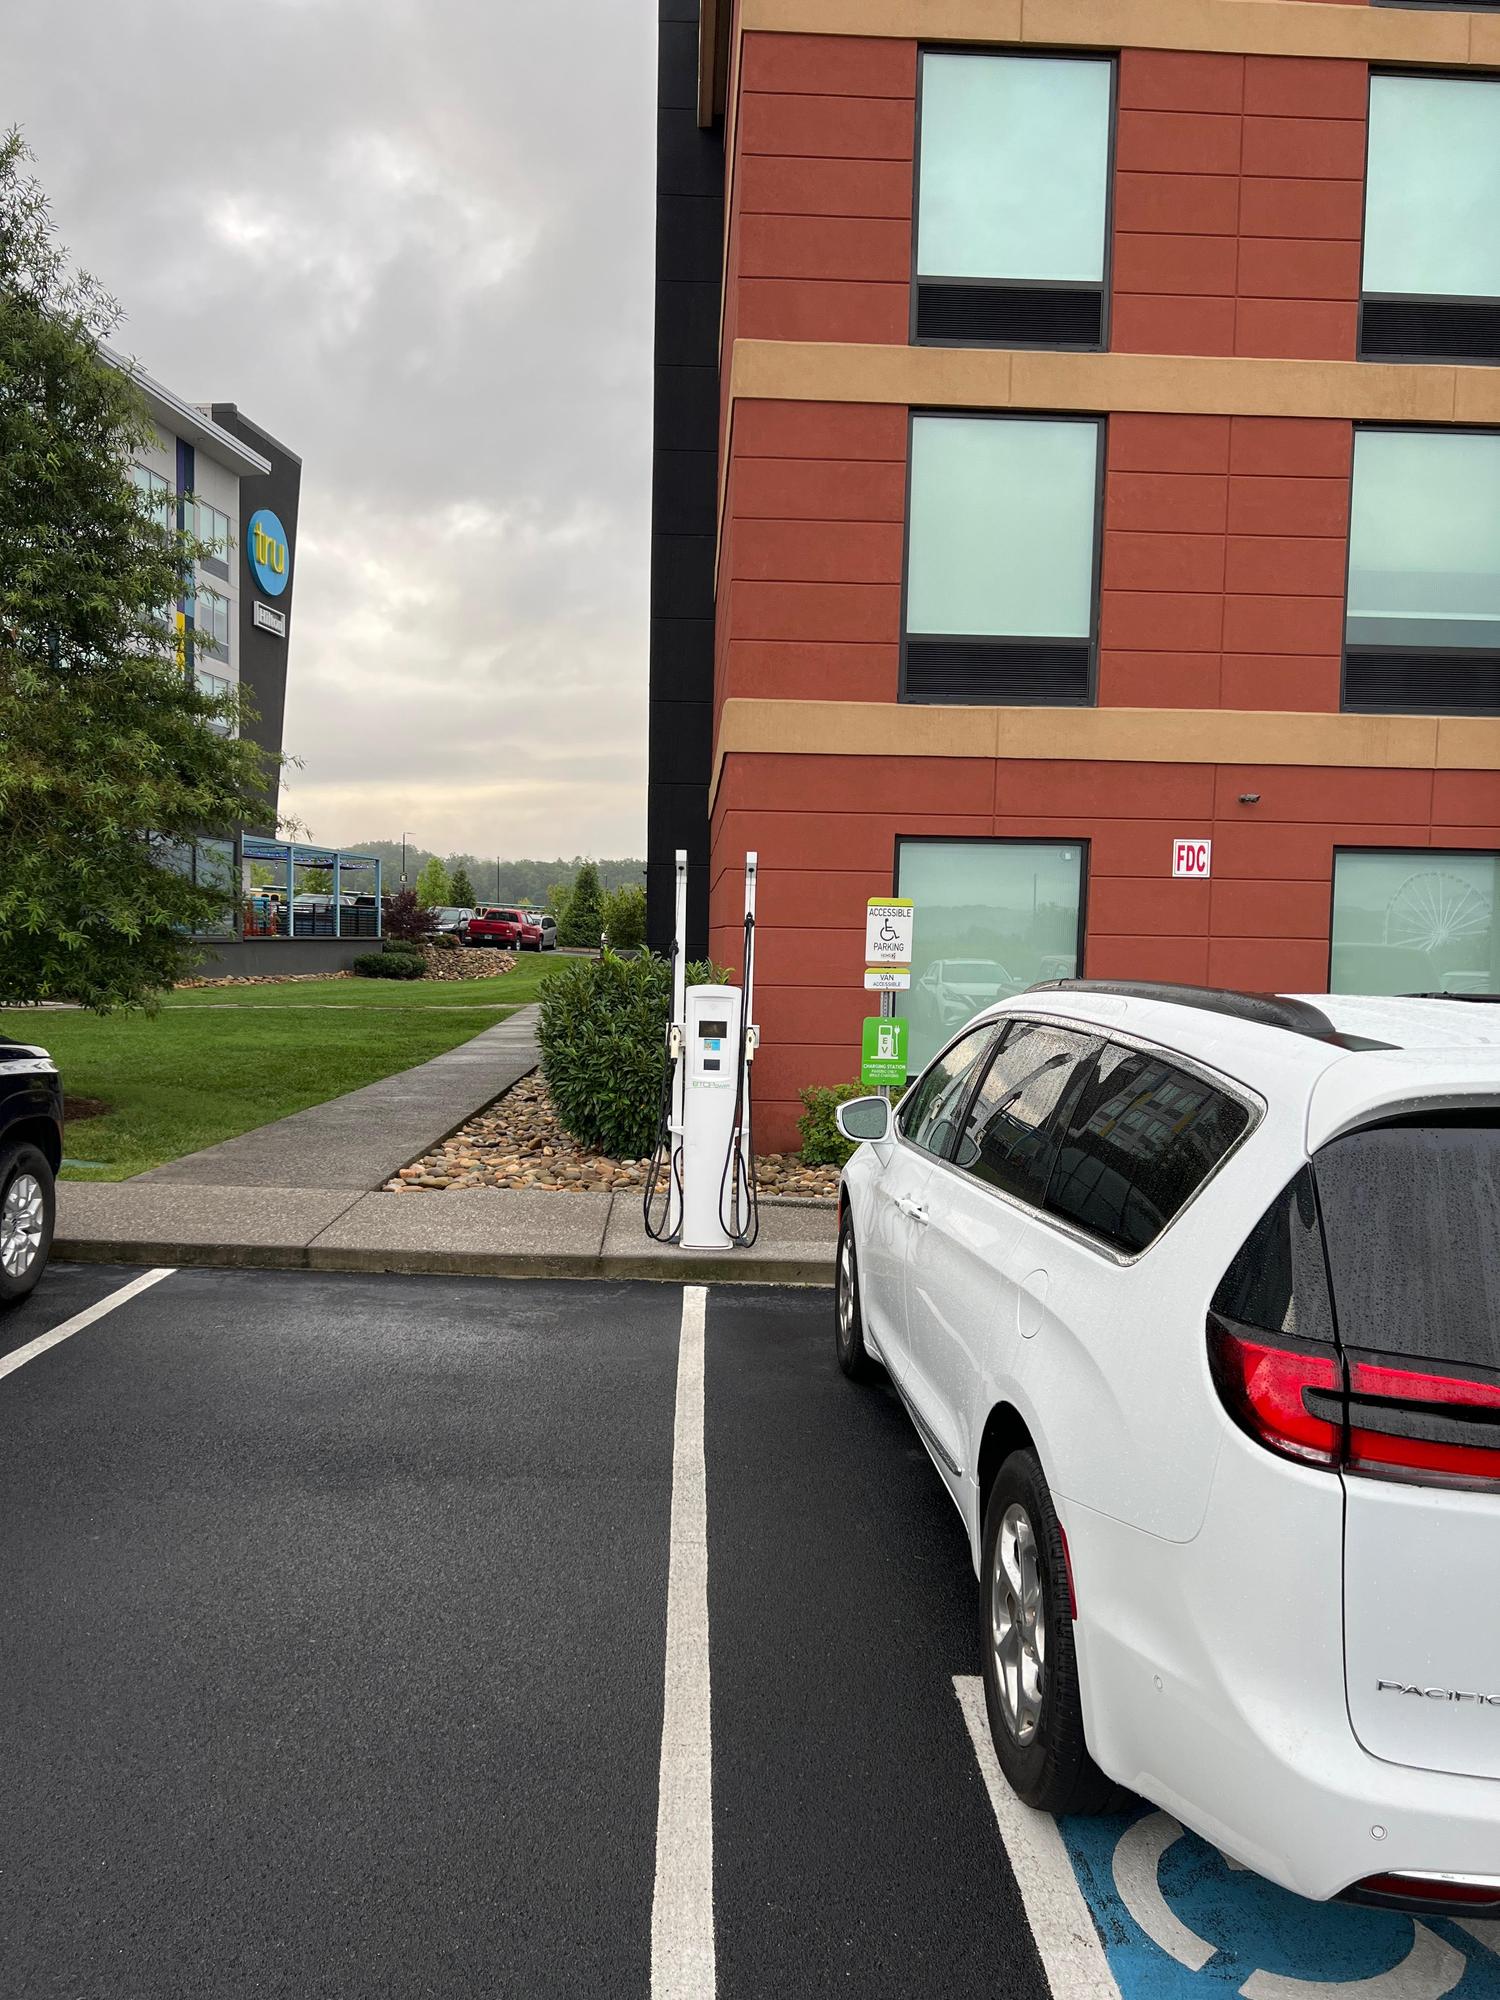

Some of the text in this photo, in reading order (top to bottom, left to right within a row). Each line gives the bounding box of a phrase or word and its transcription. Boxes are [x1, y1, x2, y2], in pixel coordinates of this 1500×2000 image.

[254, 521, 284, 574] tru
[1177, 845, 1206, 872] FDC
[869, 907, 912, 918] ACCESSIBLE
[873, 942, 905, 952] PARKING
[1377, 1679, 1500, 1706] PACIFIC
